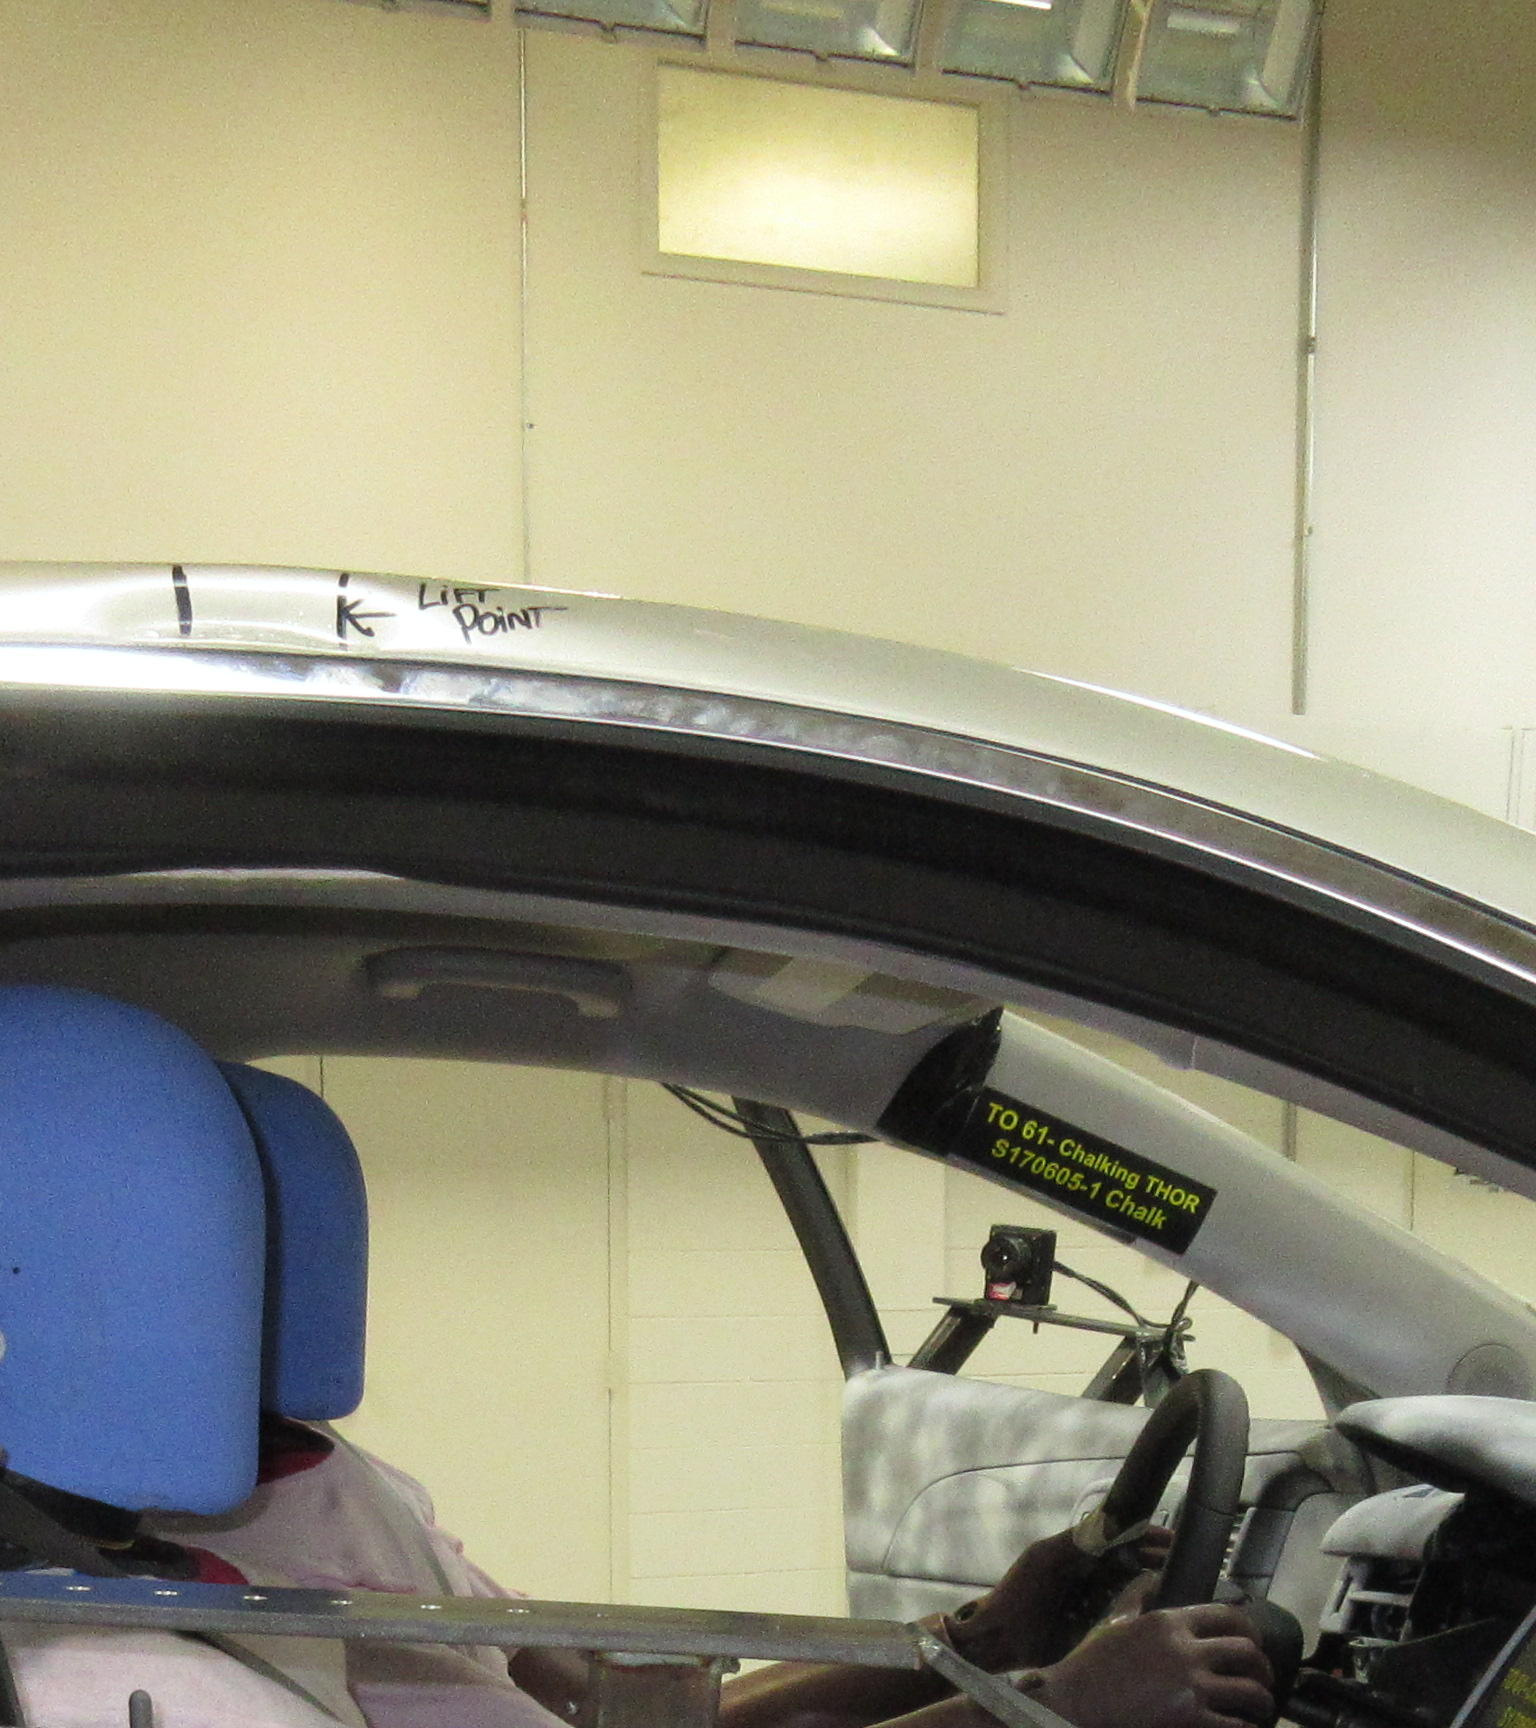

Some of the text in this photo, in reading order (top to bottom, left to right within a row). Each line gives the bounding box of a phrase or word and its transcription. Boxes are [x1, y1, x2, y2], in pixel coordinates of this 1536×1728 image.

[985, 1101, 1202, 1215] TO 61- Chalking THOR
[990, 1138, 1169, 1231] S170605-1 Chalk
